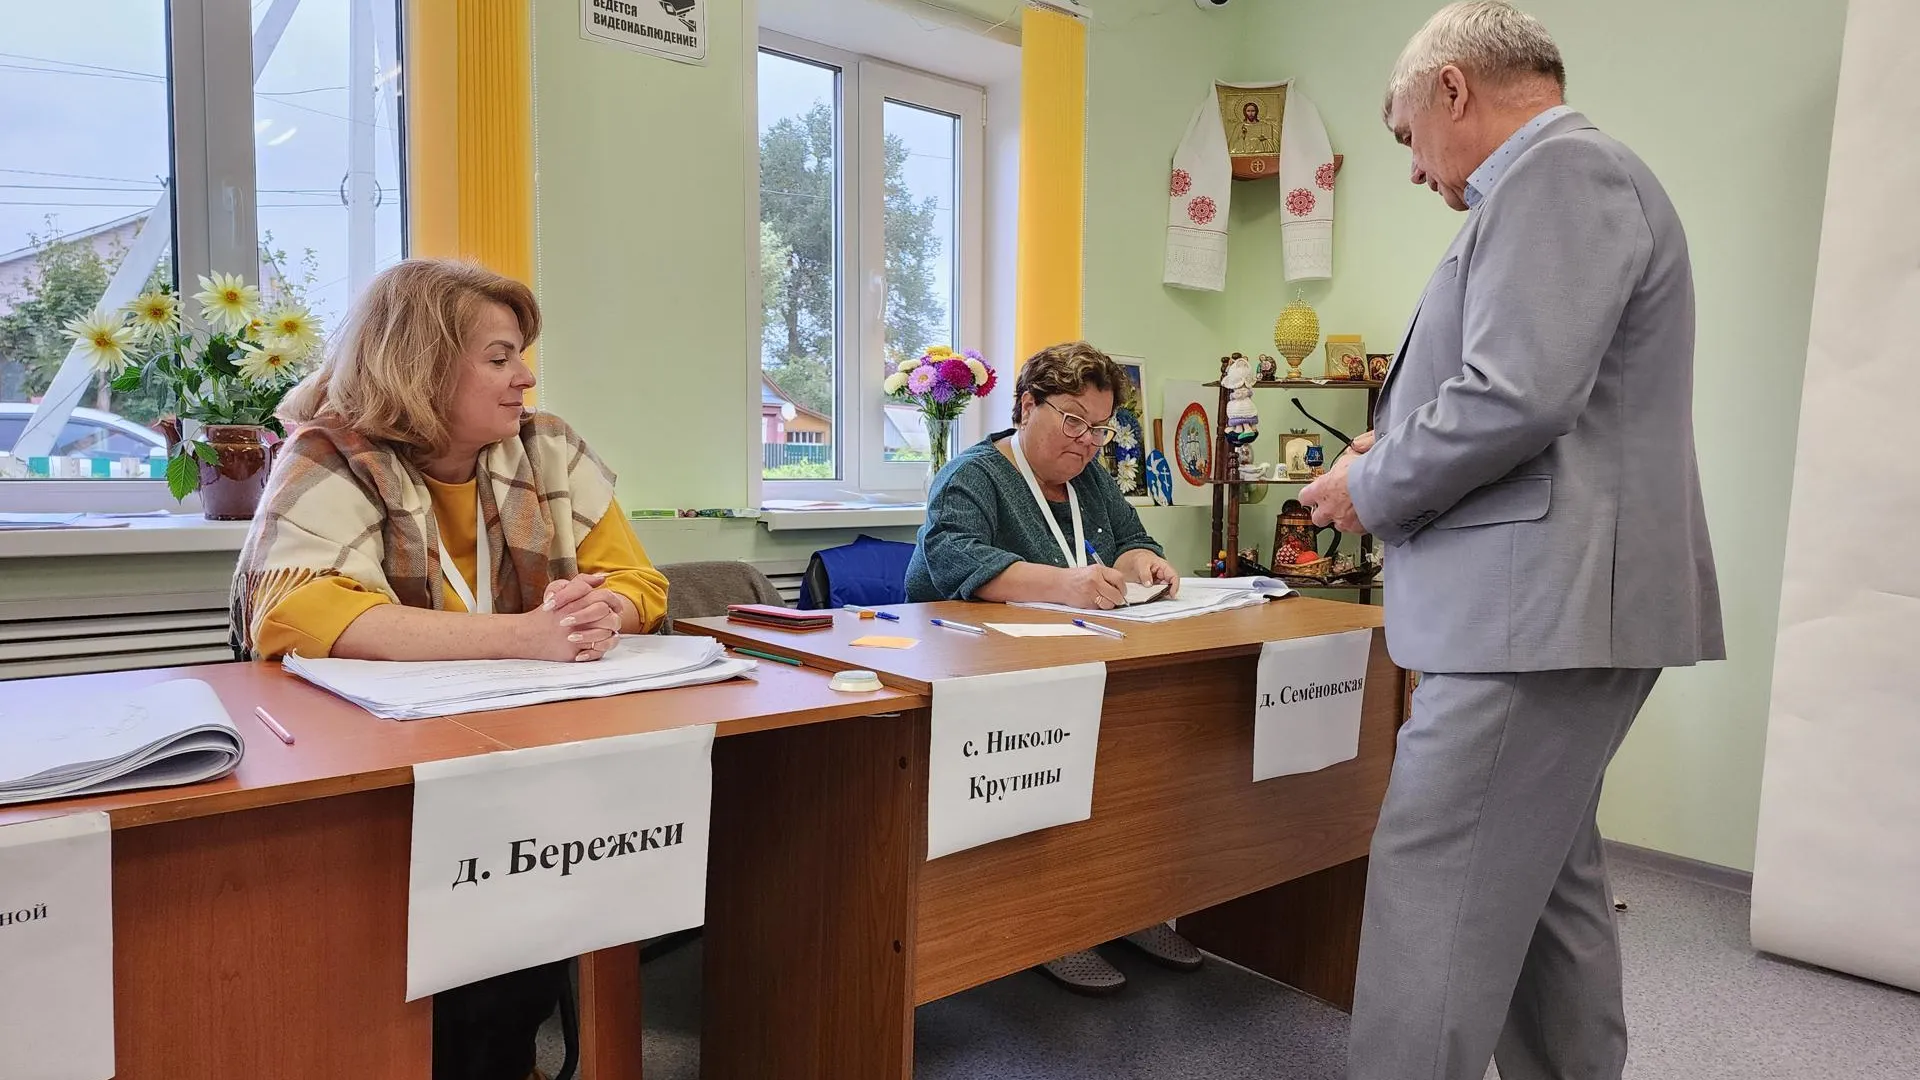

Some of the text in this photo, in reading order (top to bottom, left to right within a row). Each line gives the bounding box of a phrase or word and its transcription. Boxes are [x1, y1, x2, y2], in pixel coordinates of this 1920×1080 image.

[593, 0, 638, 18] ВЕДЕТСЯ
[593, 11, 697, 48] ВИДЕОНАБЛЮДЕНИЕ!
[1259, 676, 1364, 709] д. Семёновская
[962, 728, 1071, 758] с. Николо-
[968, 767, 1062, 803] Крутины
[451, 821, 686, 891] д. Бережки
